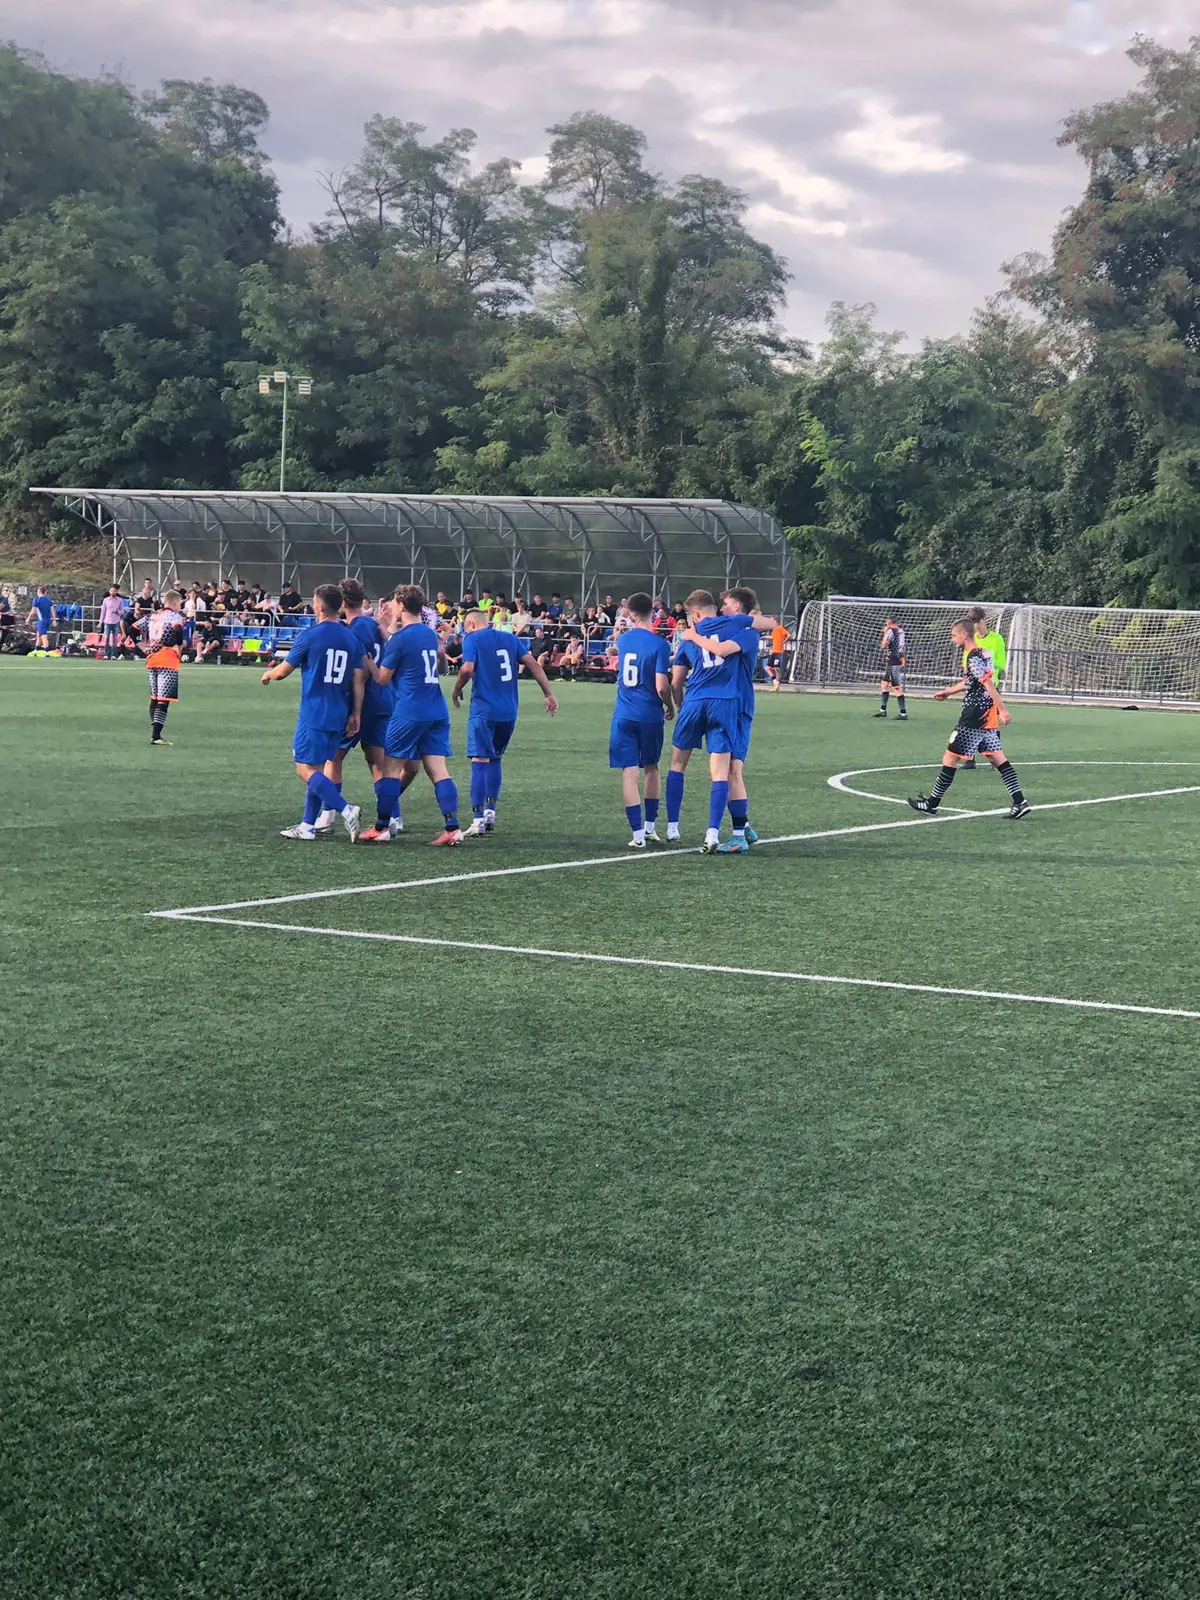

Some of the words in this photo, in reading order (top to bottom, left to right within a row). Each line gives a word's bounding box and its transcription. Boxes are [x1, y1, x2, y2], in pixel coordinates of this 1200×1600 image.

[324, 648, 348, 684] 19
[422, 649, 439, 684] 12
[496, 649, 512, 682] 3
[623, 652, 638, 688] 6
